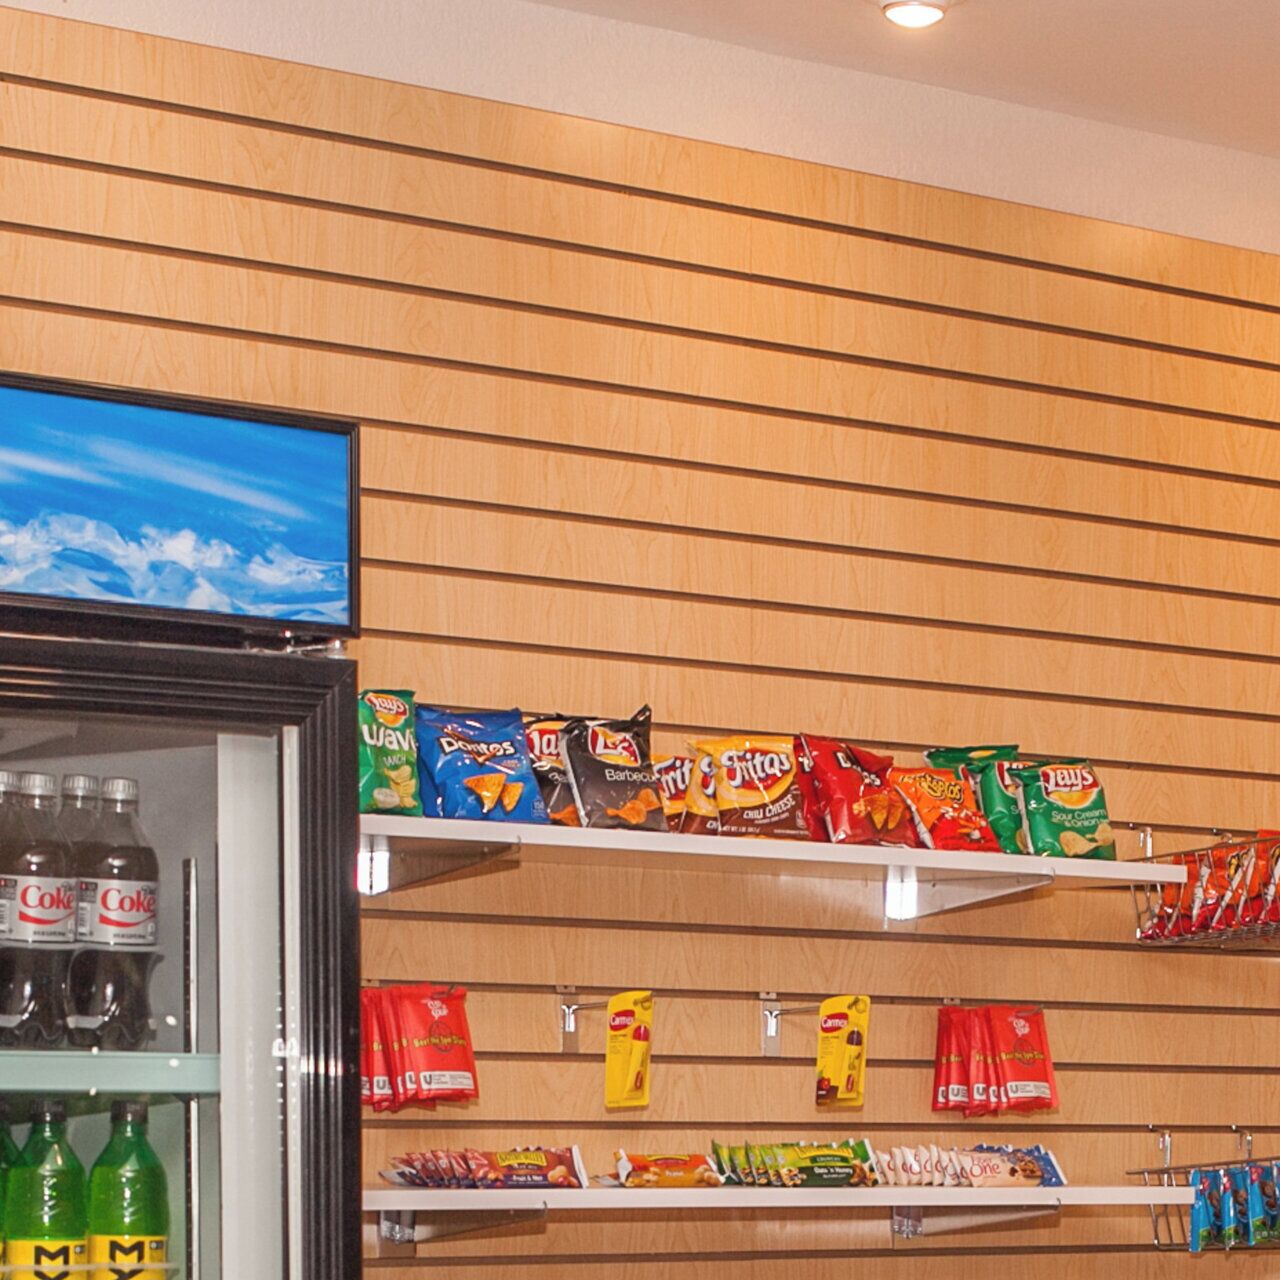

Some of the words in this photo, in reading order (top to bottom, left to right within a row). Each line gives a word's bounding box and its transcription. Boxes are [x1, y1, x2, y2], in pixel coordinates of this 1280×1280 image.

[440, 738, 515, 756] Doritos
[605, 768, 655, 782] Barbecu
[721, 749, 790, 787] Fritos
[743, 809, 764, 819] CHILI
[766, 794, 796, 817] CHEESE
[1052, 810, 1071, 821] Sour
[1074, 809, 1106, 820] Cream
[1071, 818, 1101, 828] Onion
[20, 884, 74, 910] Coke
[100, 887, 155, 913] Coke
[970, 1161, 1001, 1177] One
